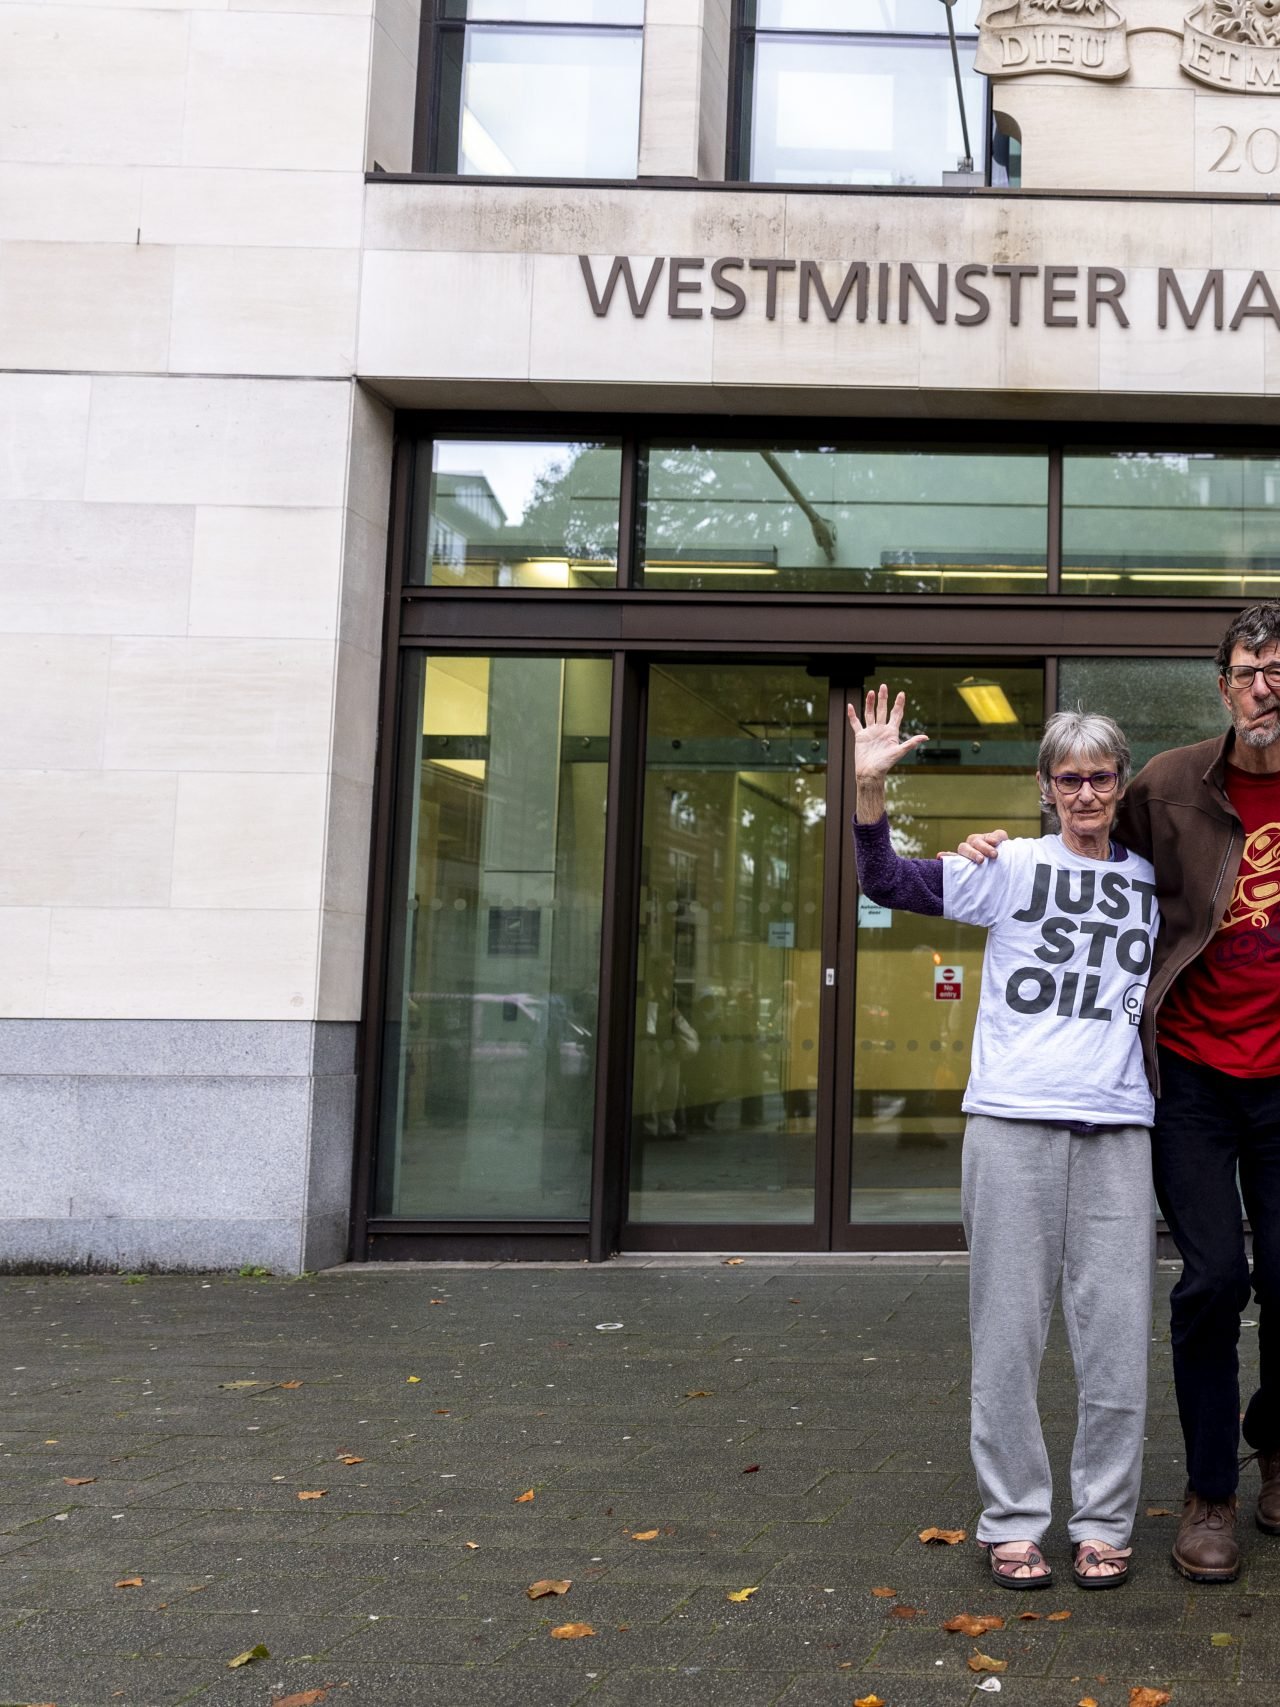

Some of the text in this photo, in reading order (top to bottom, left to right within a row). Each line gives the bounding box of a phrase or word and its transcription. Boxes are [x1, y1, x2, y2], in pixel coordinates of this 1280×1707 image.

[1000, 34, 1107, 67] DIEU
[1189, 38, 1239, 81] ET
[579, 255, 1130, 329] WESTMINSTER
[1011, 863, 1157, 926] JUST
[1034, 916, 1157, 976] STO
[939, 991, 958, 999] entry
[1005, 966, 1113, 1022] OIL
